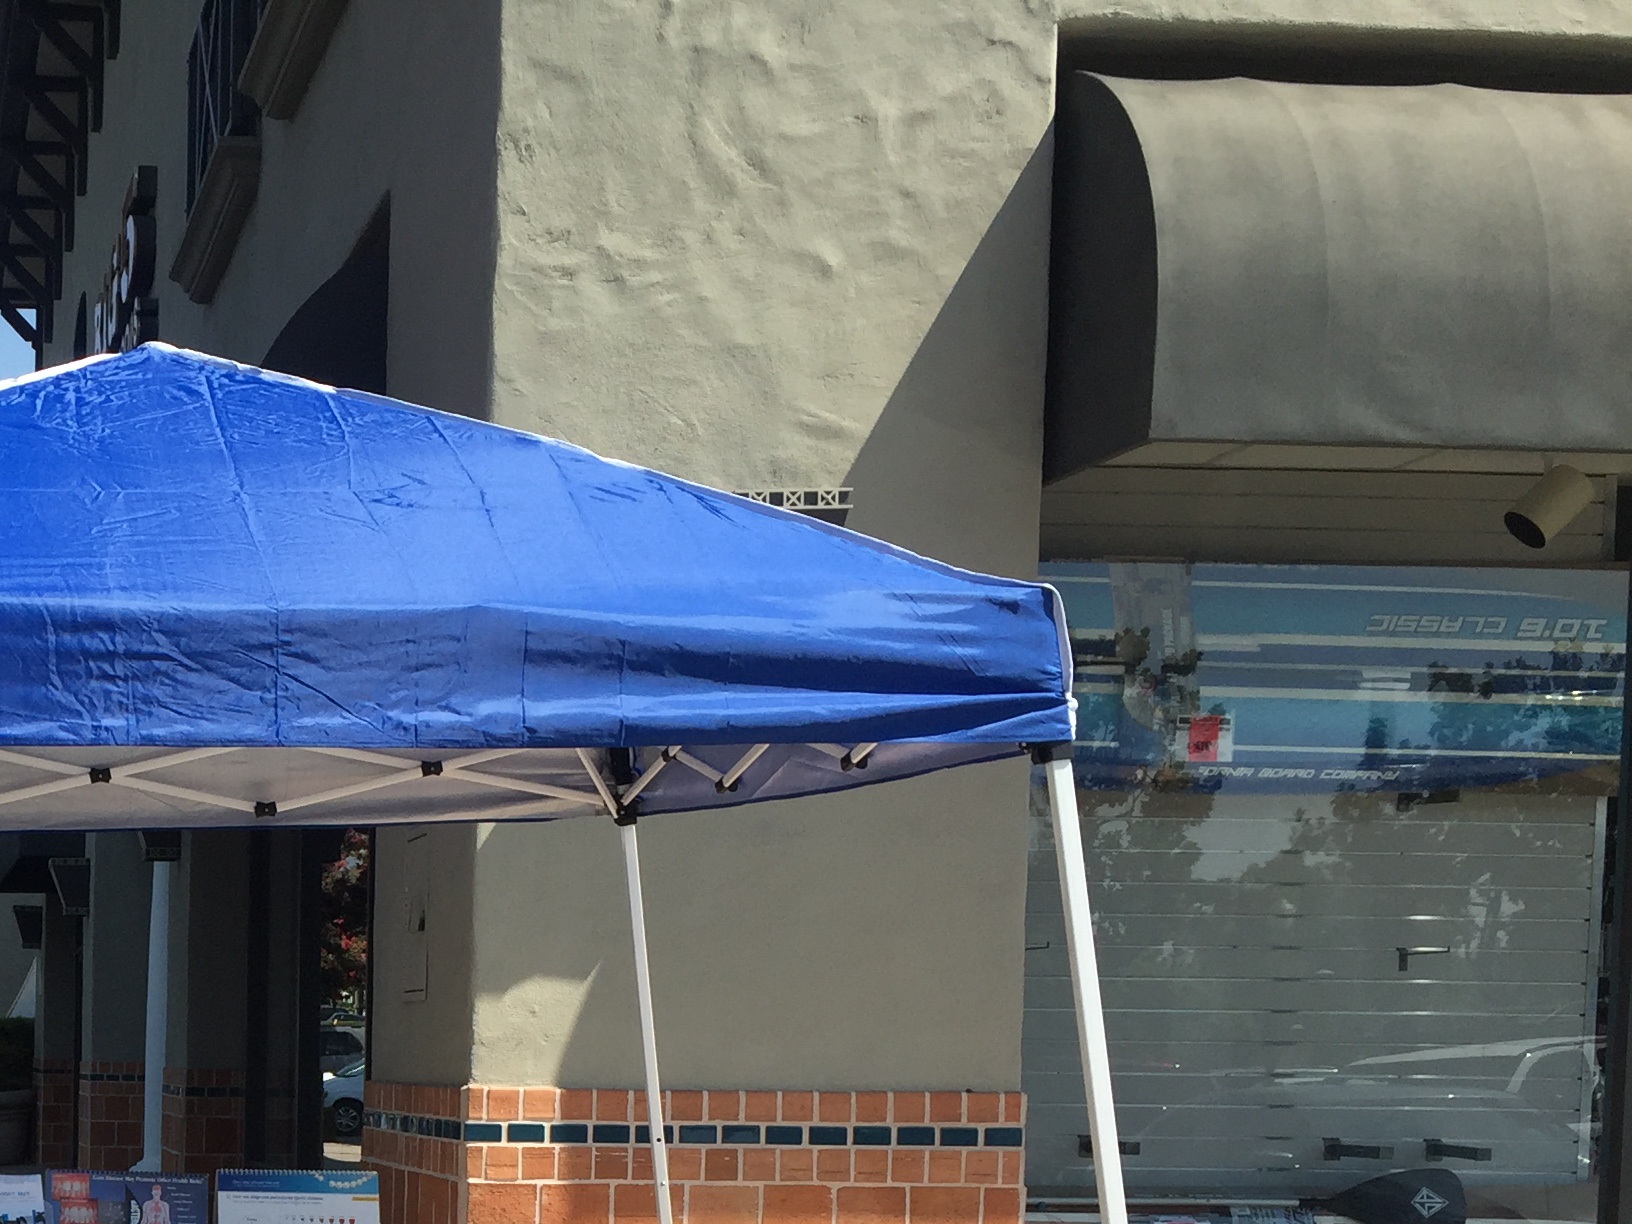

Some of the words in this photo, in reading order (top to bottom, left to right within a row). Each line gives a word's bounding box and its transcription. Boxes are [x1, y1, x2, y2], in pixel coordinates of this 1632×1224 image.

[1366, 614, 1507, 634] CLASSIC
[1517, 617, 1608, 639] 10'6
[1257, 767, 1315, 779] BOARD
[1320, 768, 1401, 782] COMPANY
